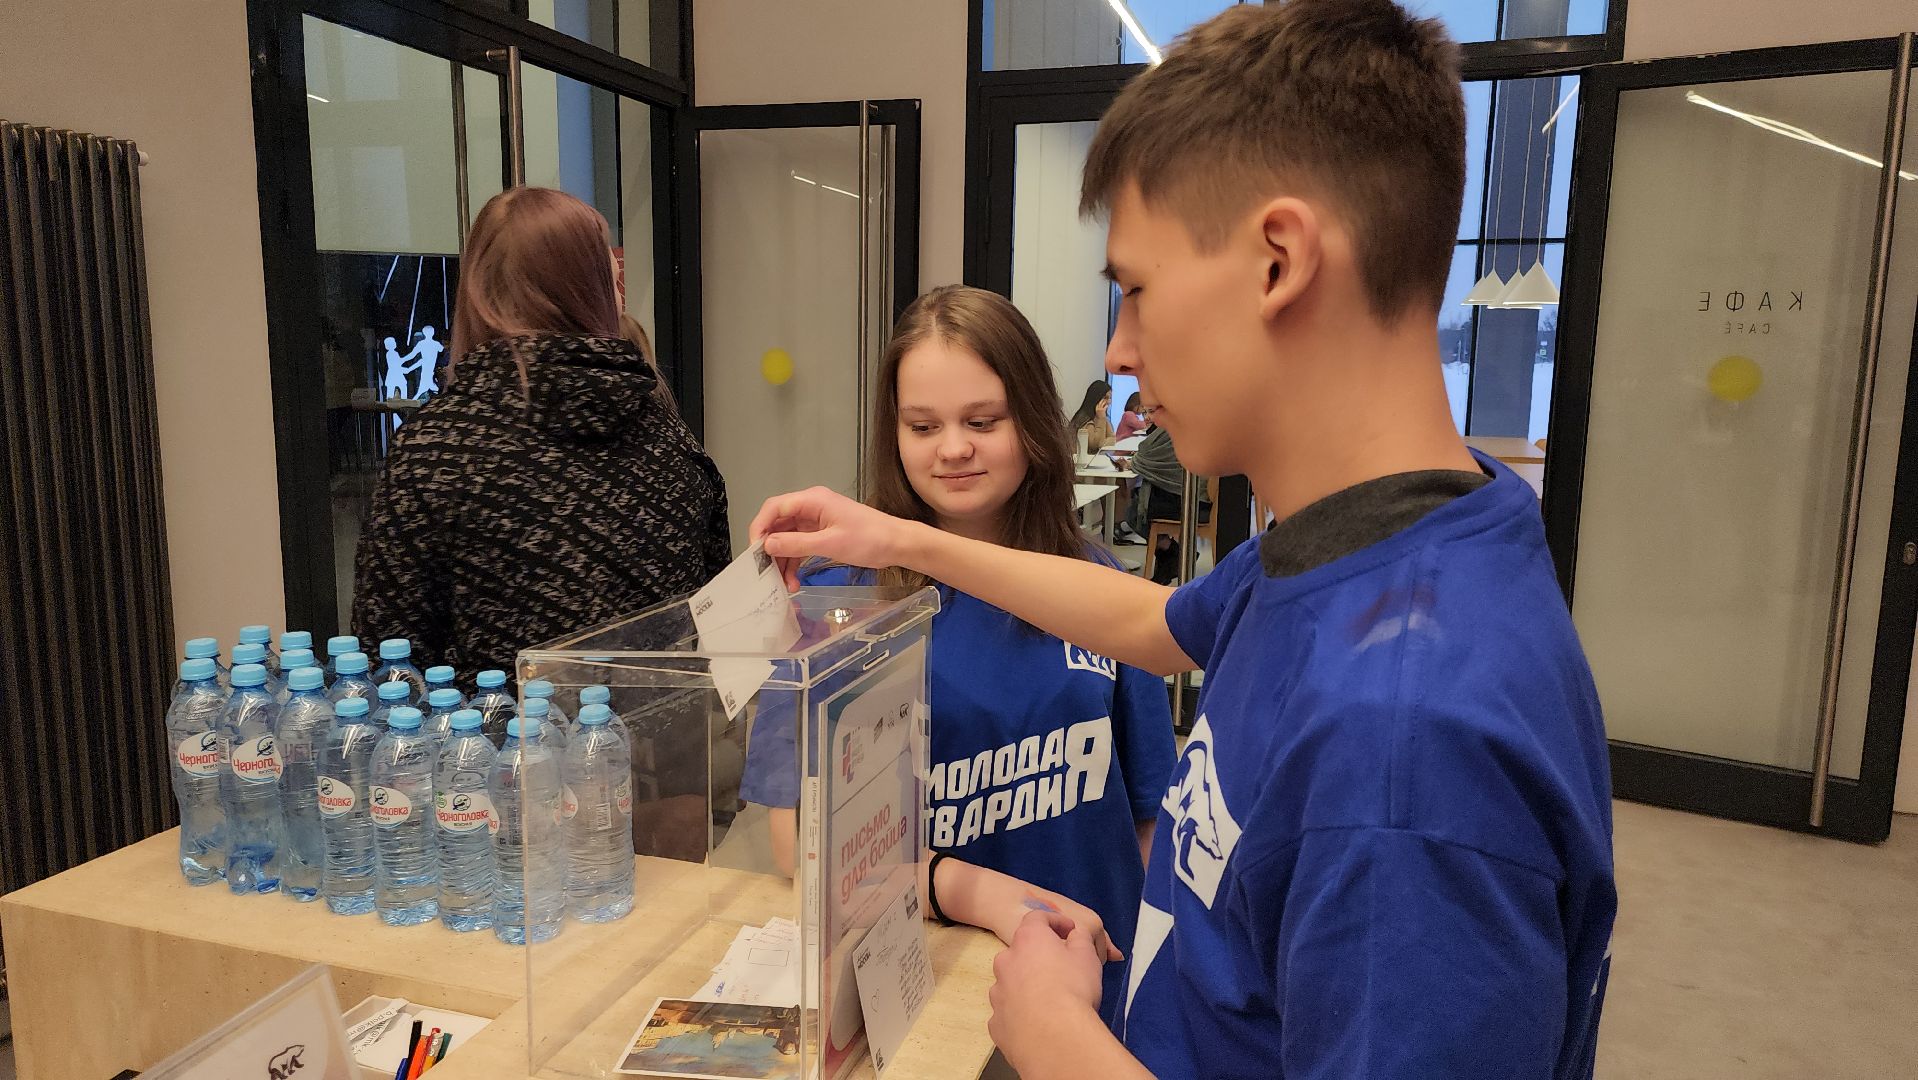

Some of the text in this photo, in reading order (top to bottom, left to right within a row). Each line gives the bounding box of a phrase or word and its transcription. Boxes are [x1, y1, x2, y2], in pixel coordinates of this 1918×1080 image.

[841, 803, 891, 868] письмо
[841, 855, 868, 905] для
[869, 815, 908, 867] бойца
